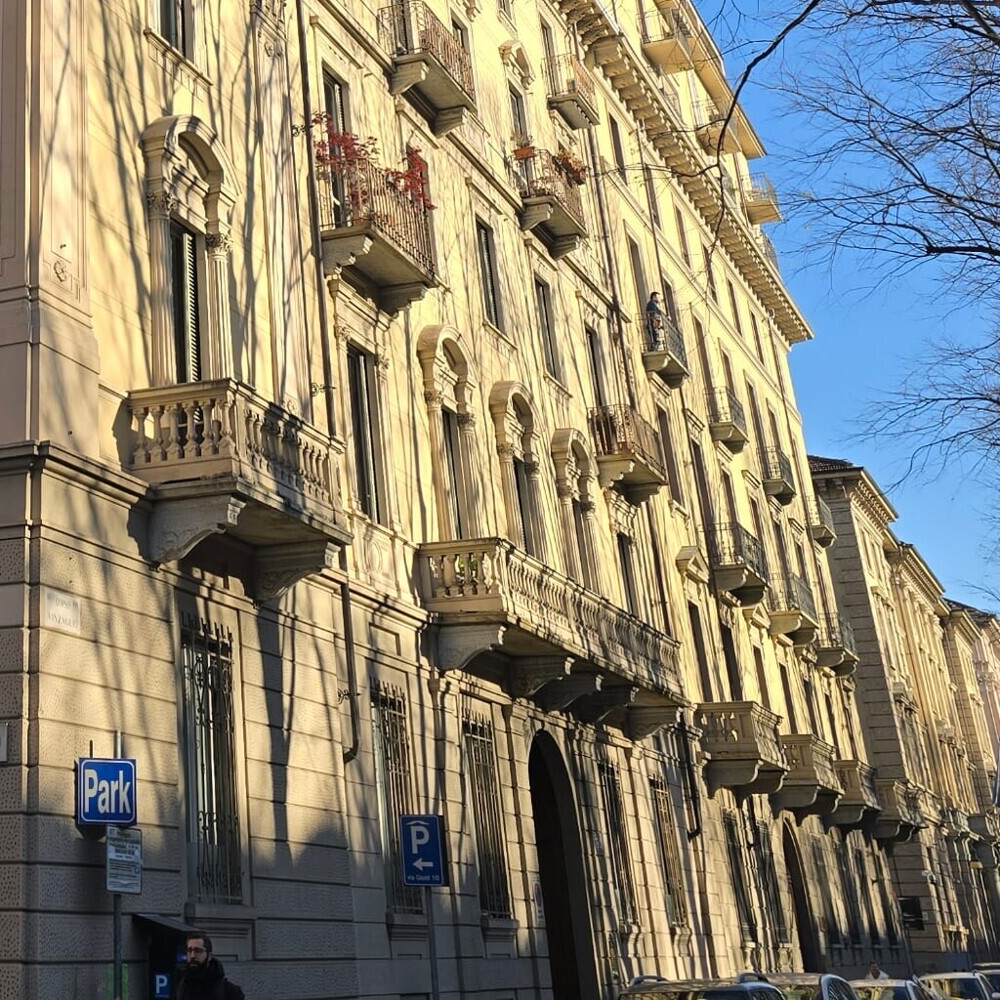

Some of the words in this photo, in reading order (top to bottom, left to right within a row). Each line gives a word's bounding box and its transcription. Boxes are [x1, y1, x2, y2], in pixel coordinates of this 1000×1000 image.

[84, 769, 131, 814] Park
[410, 825, 430, 855] P
[155, 974, 168, 994] P
